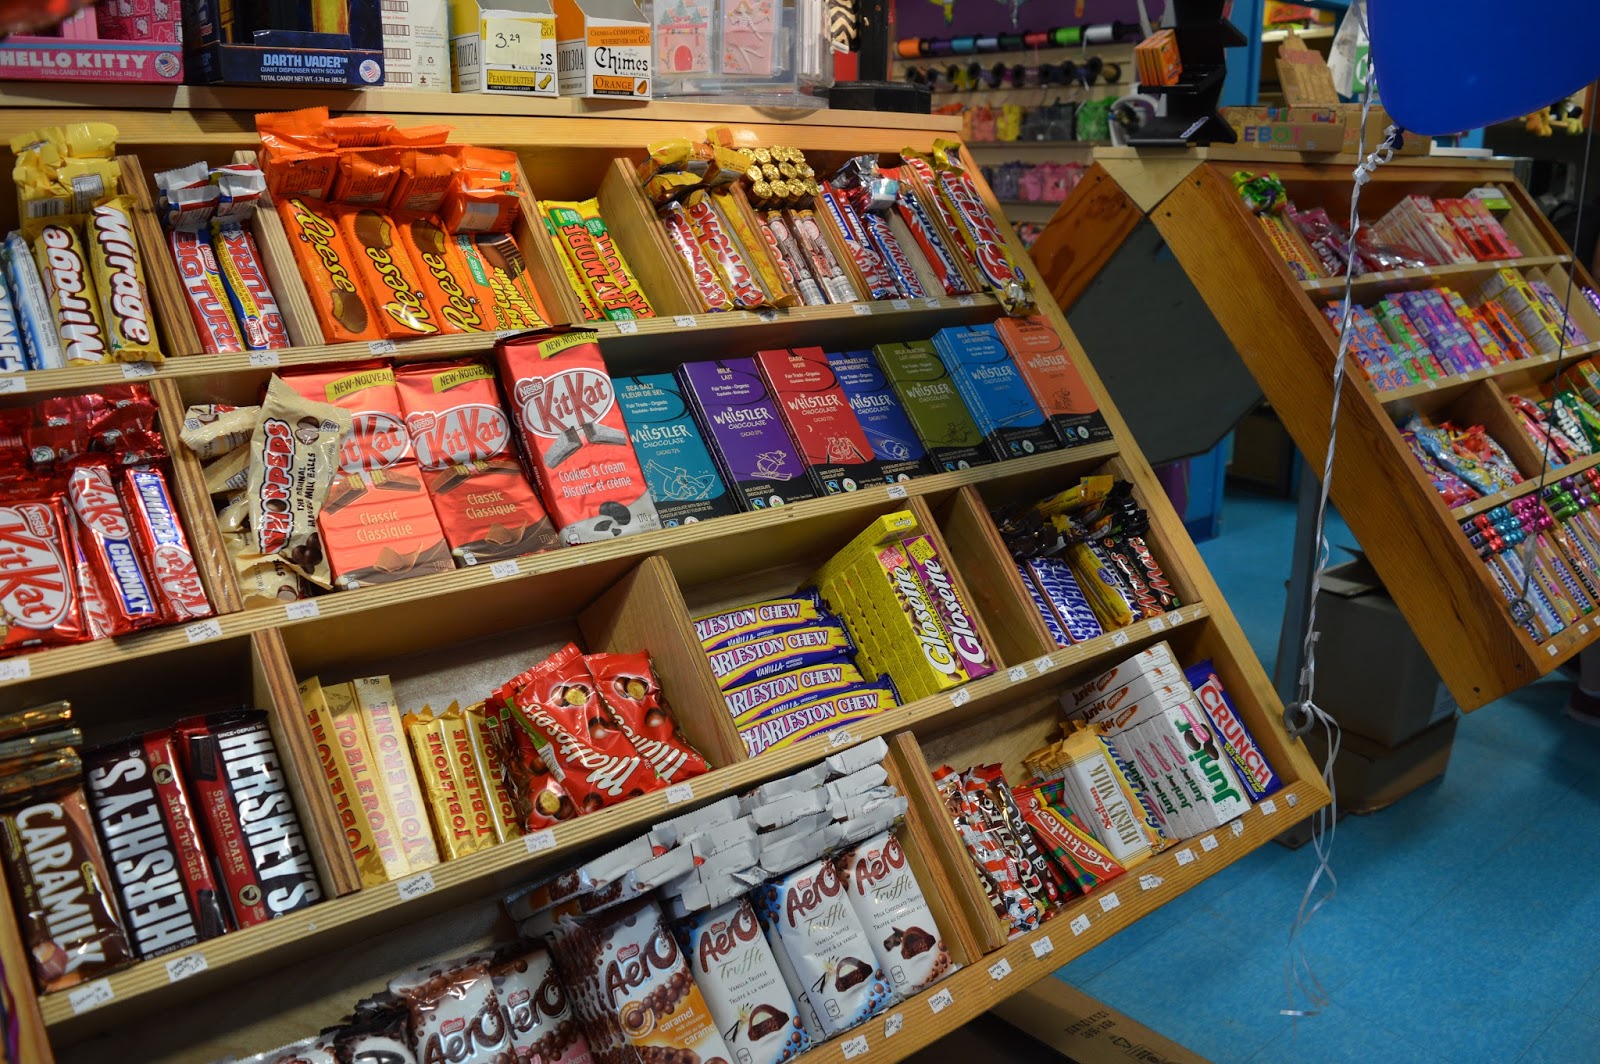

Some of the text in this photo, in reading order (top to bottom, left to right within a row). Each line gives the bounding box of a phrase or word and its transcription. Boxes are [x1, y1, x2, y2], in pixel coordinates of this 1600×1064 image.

[495, 32, 520, 49] 3.29
[638, 33, 650, 44] GO!
[0, 51, 148, 69] HELLO KITTY
[263, 54, 302, 67] DARTH
[594, 46, 649, 75] Chimes
[488, 72, 533, 85] PEANUT BUTTER
[595, 77, 633, 90] ORANGE
[291, 199, 356, 294] Reese
[92, 205, 150, 345] Mirage
[562, 223, 633, 311] EAT-MORE
[43, 224, 106, 363] Mirage
[175, 231, 243, 354] BIG TURK
[222, 234, 288, 349] BIG TURK
[366, 247, 440, 333] Reese
[422, 252, 482, 333] Reese
[545, 331, 595, 352] NEW NOUVEAU
[333, 372, 392, 395] NEW NOUVEAU
[440, 366, 494, 387] NEW NOUVEAU
[640, 383, 654, 391] SALT
[534, 372, 608, 433] KitKat
[621, 391, 642, 399] FLEUR
[802, 407, 837, 416] CHOCOLATE
[858, 406, 890, 414] CHOCOLATE
[426, 407, 503, 467] KitKat
[728, 420, 766, 430] CHOCOLATE
[340, 415, 403, 471] itKat
[643, 437, 685, 448] CHOCOLATE
[261, 421, 291, 553] WHOPPERS
[558, 462, 626, 483] Cookies & Cream
[562, 476, 632, 498] Biscuits et crème
[72, 473, 126, 534] KitKat
[466, 502, 516, 520] Classique
[467, 490, 504, 506] Classic
[359, 509, 400, 526] Classic
[637, 513, 647, 523] 170
[356, 523, 413, 543] Classique
[109, 544, 150, 614] CHUNKY
[694, 604, 799, 642] RLESTON CHEW
[894, 567, 956, 675] Glosette
[924, 559, 985, 664] Glosette
[710, 631, 827, 677] ARLESTON CHEW
[755, 663, 785, 677] VANILLA
[725, 668, 841, 717] ARLESTON CHEW
[840, 693, 879, 713] CHEW
[1201, 685, 1271, 785] CRUNCH
[521, 703, 641, 797] Maltesers
[334, 714, 398, 864] TOBLERONE
[370, 701, 428, 853] TOBLERONE
[427, 732, 472, 841] TOBLERONE
[453, 729, 494, 838] TOBLERONE
[1088, 764, 1142, 846] JERSEY MILK
[167, 796, 202, 882] SPECIAL DARK
[213, 790, 247, 875] SPECIAL DARK
[16, 802, 106, 973] CARAMILK
[870, 873, 913, 904] Truffle
[804, 901, 848, 938] Truffle
[873, 900, 907, 920] MILK CHOCOLATE
[873, 907, 918, 931] TRUFFE CHOCOLAT
[814, 926, 850, 947] VANILLA TRUFFLE
[717, 945, 765, 983] Truffle
[814, 946, 832, 958] TRUFFE
[728, 970, 768, 993] VANILLA TRUFFLE
[729, 993, 746, 1005] TRUFFE
[660, 1007, 694, 1033] caramel
[686, 1013, 706, 1029] chocolate
